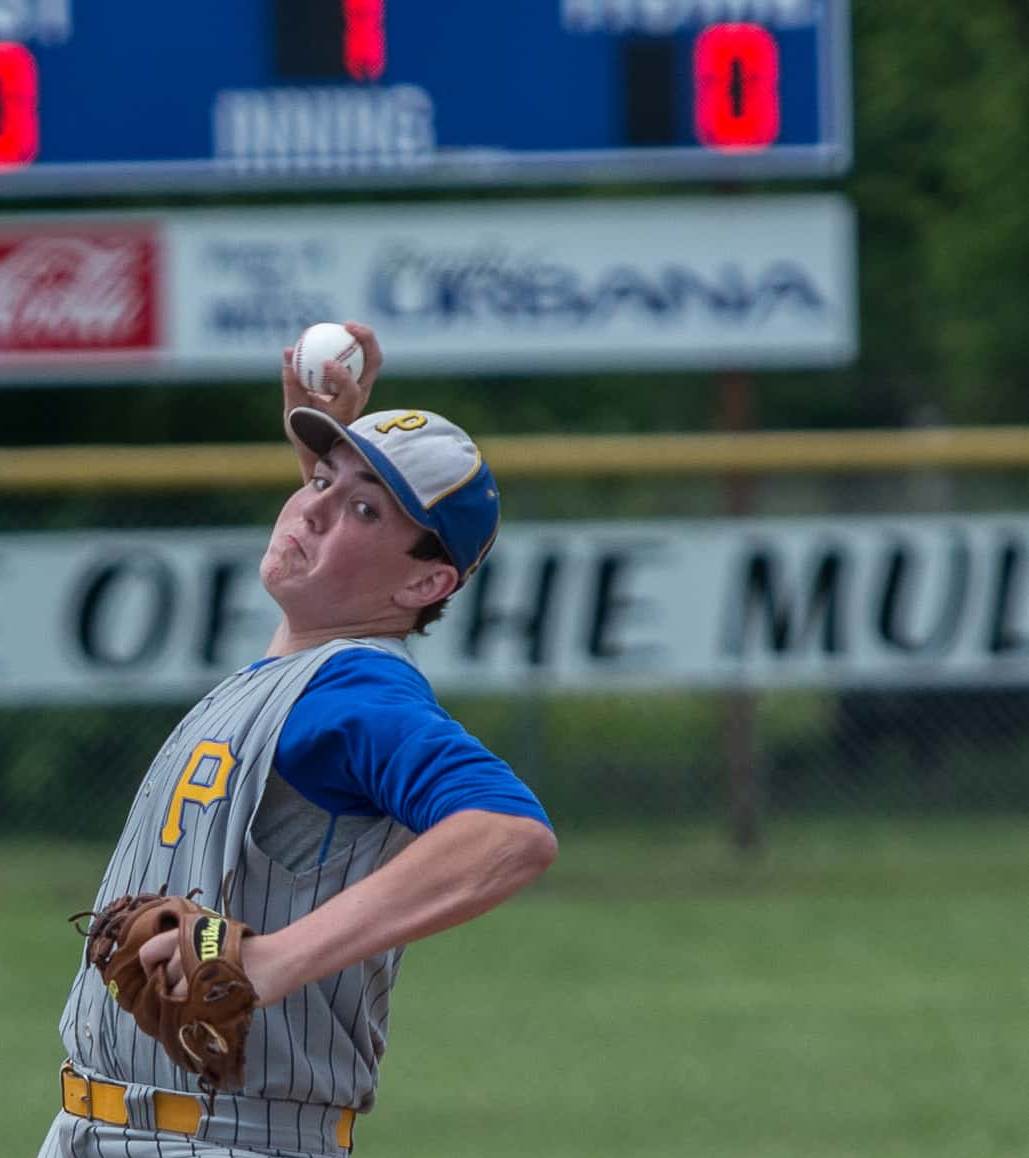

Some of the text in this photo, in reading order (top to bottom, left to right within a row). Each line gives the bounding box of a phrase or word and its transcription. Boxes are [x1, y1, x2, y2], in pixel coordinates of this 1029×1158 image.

[214, 84, 435, 168] INNING
[693, 22, 780, 153] 0
[67, 546, 263, 672] OF
[459, 535, 668, 668] HE
[159, 736, 242, 848] P
